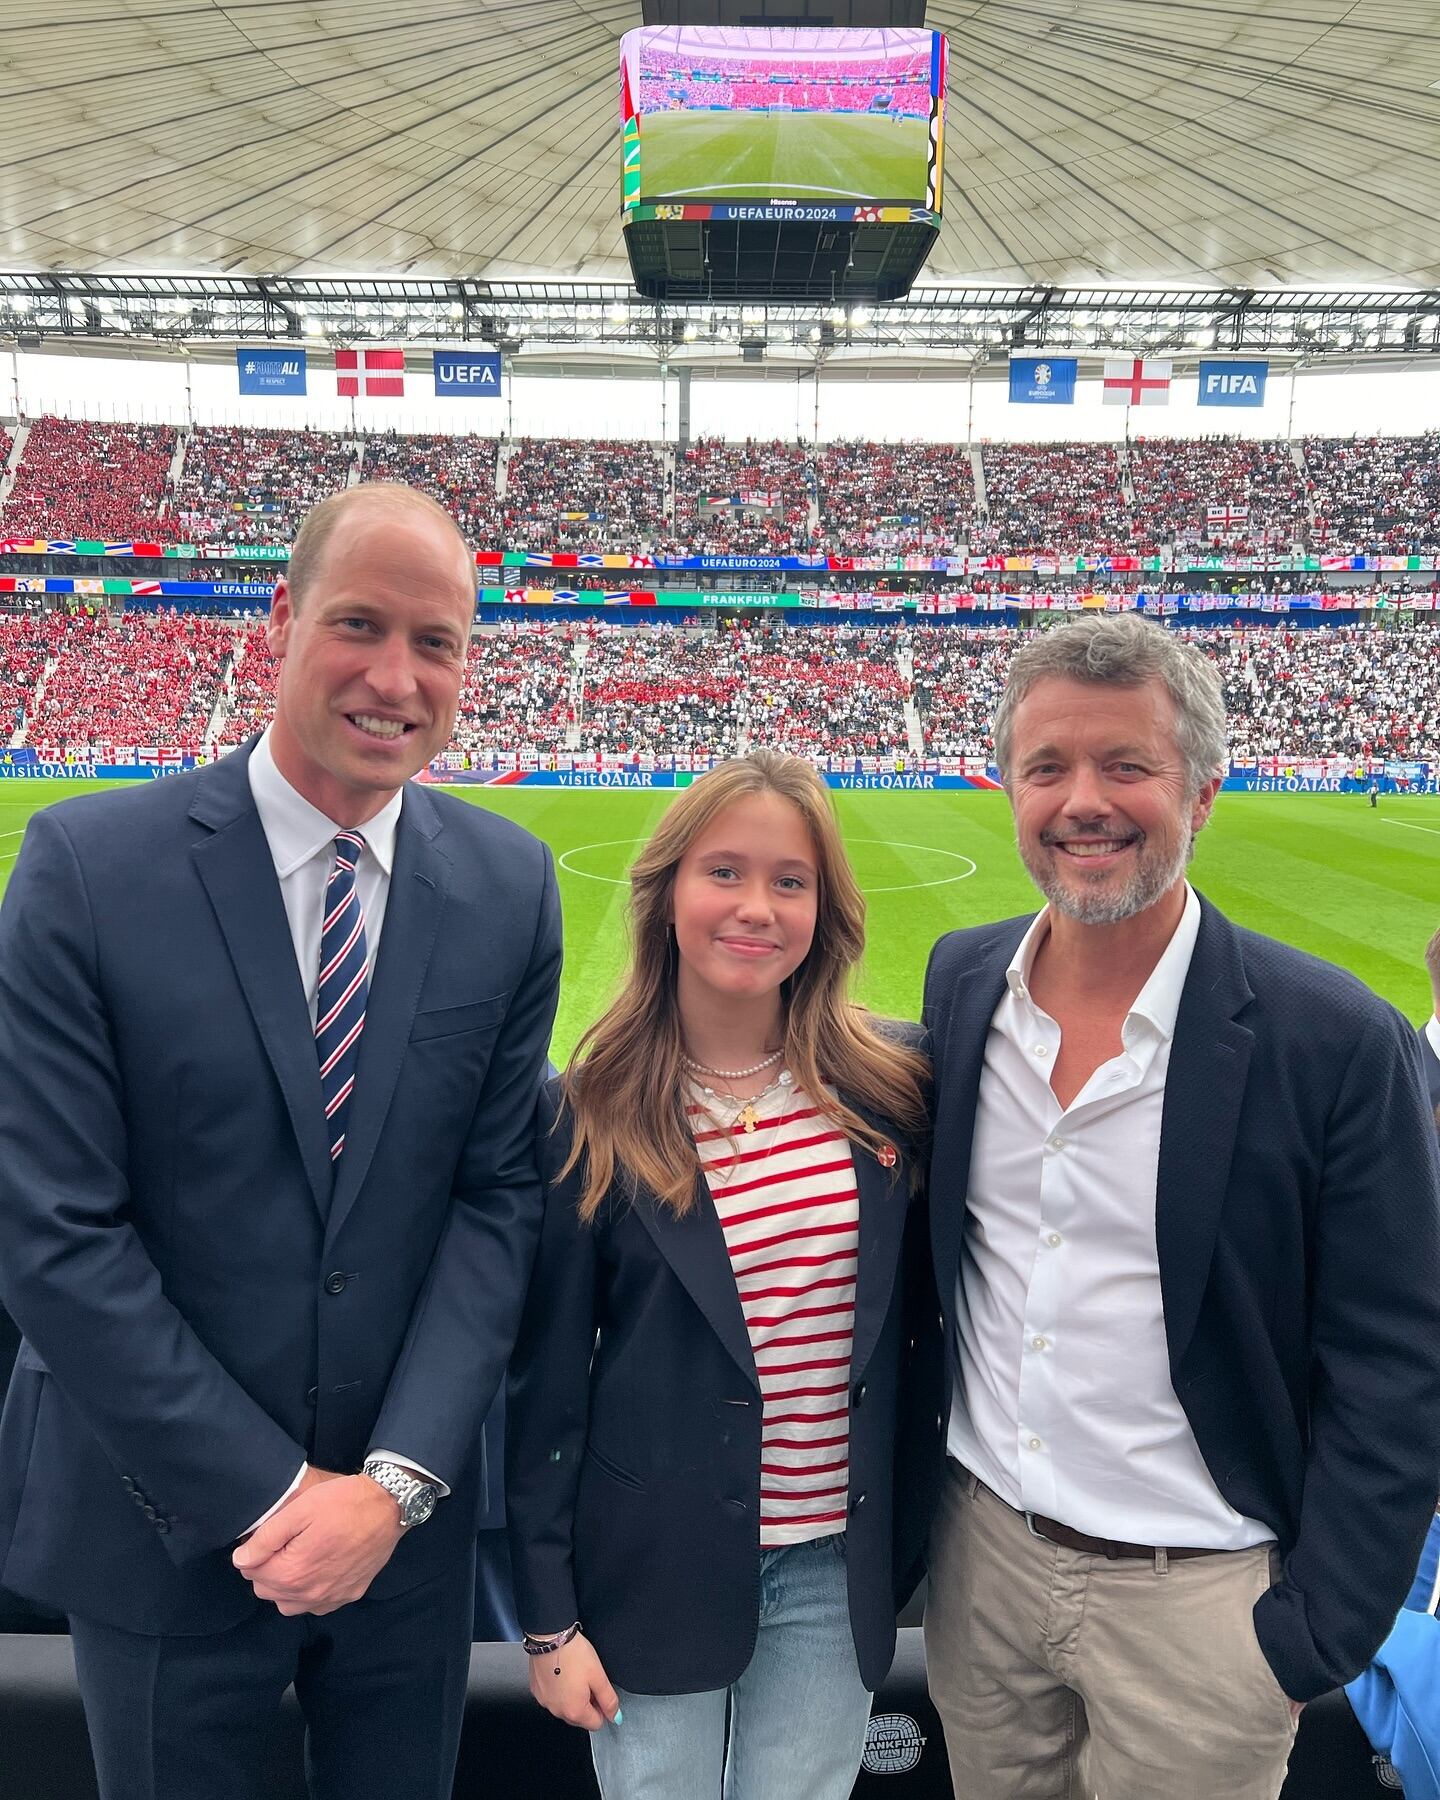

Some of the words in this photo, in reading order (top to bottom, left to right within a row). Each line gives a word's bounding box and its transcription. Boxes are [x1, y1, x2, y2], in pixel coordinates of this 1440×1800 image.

[728, 207, 837, 219] UEFAEURO2024
[440, 365, 495, 383] UEFA
[1207, 375, 1257, 394] FIFA
[701, 558, 781, 568] UEFAEURO2024
[703, 595, 779, 605] FRANKFURT
[1, 763, 98, 778] visitQATAR
[558, 771, 653, 786] visitQATAR
[840, 774, 934, 789] visitQATAR
[1246, 776, 1341, 792] visitQATAR
